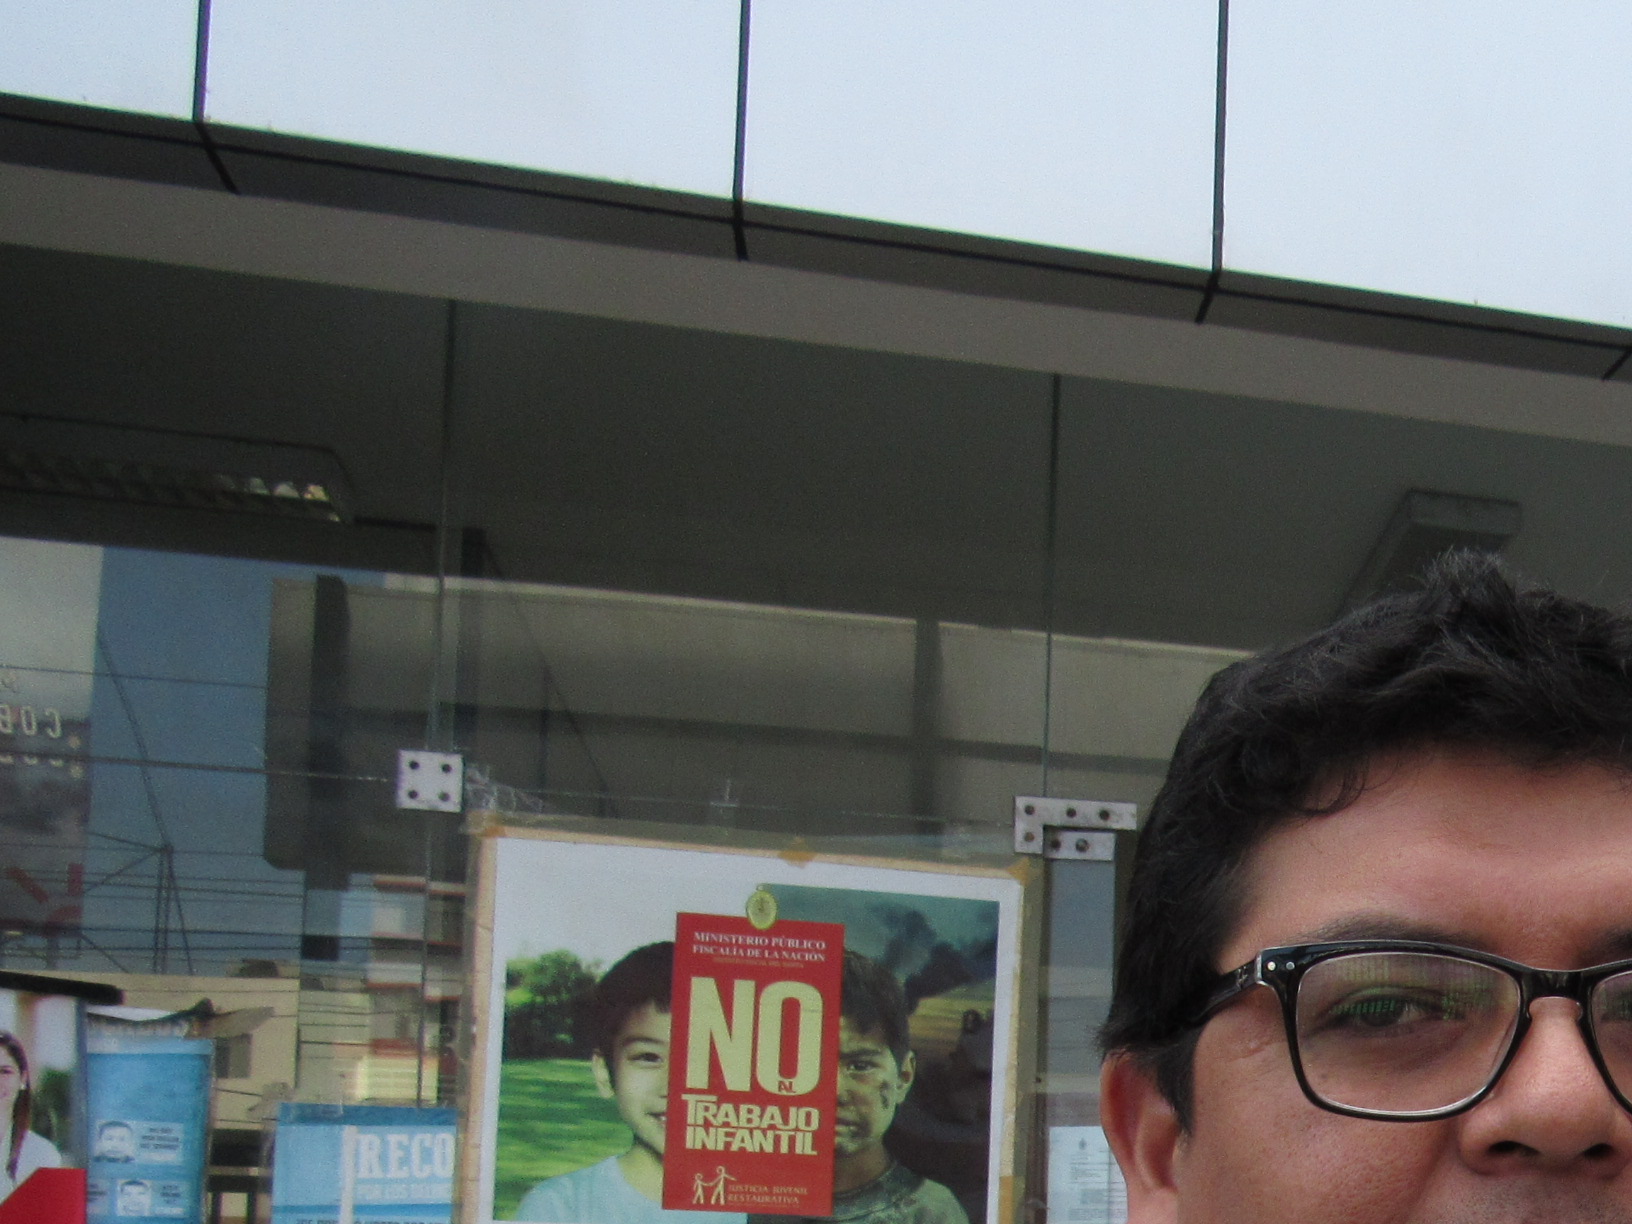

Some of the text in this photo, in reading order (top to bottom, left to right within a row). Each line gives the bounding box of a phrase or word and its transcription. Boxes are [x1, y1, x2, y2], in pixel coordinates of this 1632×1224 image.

[694, 932, 826, 950] MINISTERIO PÚBLICO
[693, 945, 745, 957] FISCALÍA
[747, 950, 762, 959] DE
[764, 951, 779, 960] LA
[781, 951, 826, 962] NACIÓN
[686, 976, 823, 1095] NO
[778, 1080, 796, 1093] AL
[681, 1093, 820, 1131] TRABAJO
[686, 1125, 818, 1156] INFANTIL
[727, 1193, 799, 1204] RESTAURATIVA
